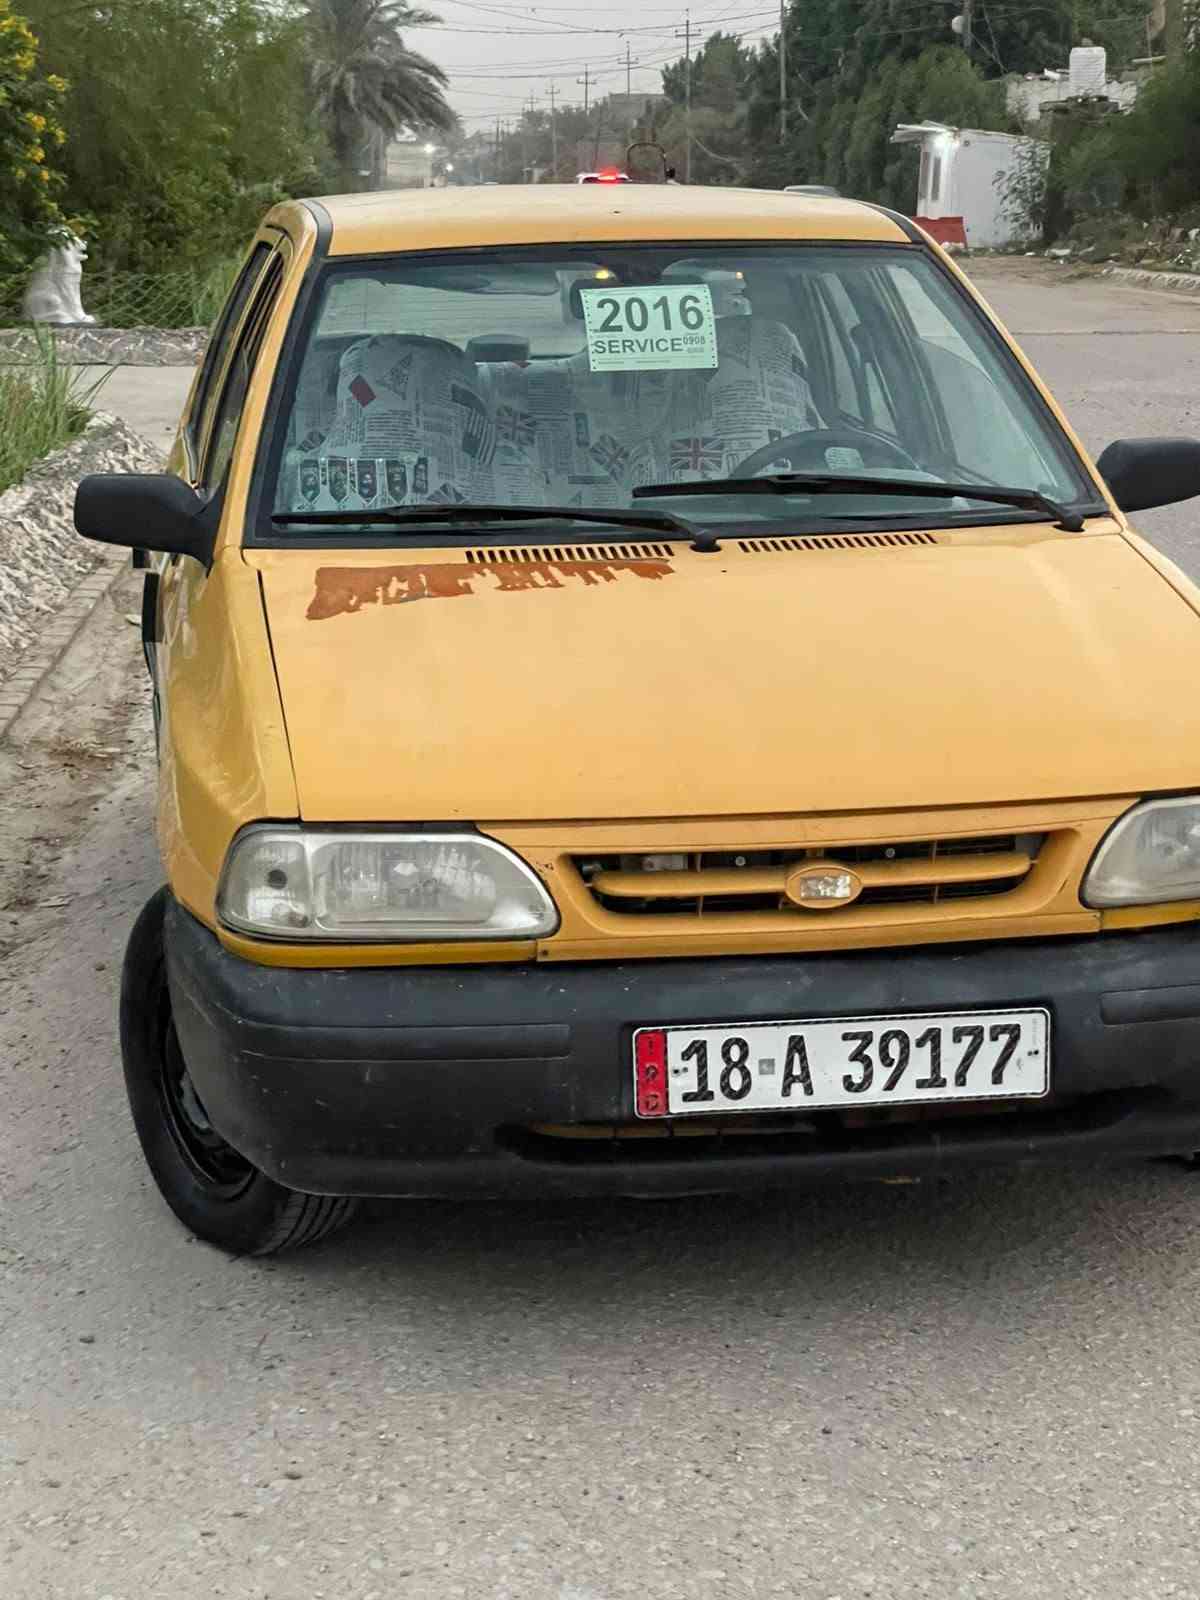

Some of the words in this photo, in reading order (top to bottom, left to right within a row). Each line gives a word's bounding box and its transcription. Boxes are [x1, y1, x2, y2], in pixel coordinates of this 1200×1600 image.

[597, 295, 704, 332] 2016
[594, 338, 683, 354] SERVICE
[681, 1037, 752, 1103] 18
[781, 1034, 814, 1097] A
[841, 1023, 1022, 1093] 39177
